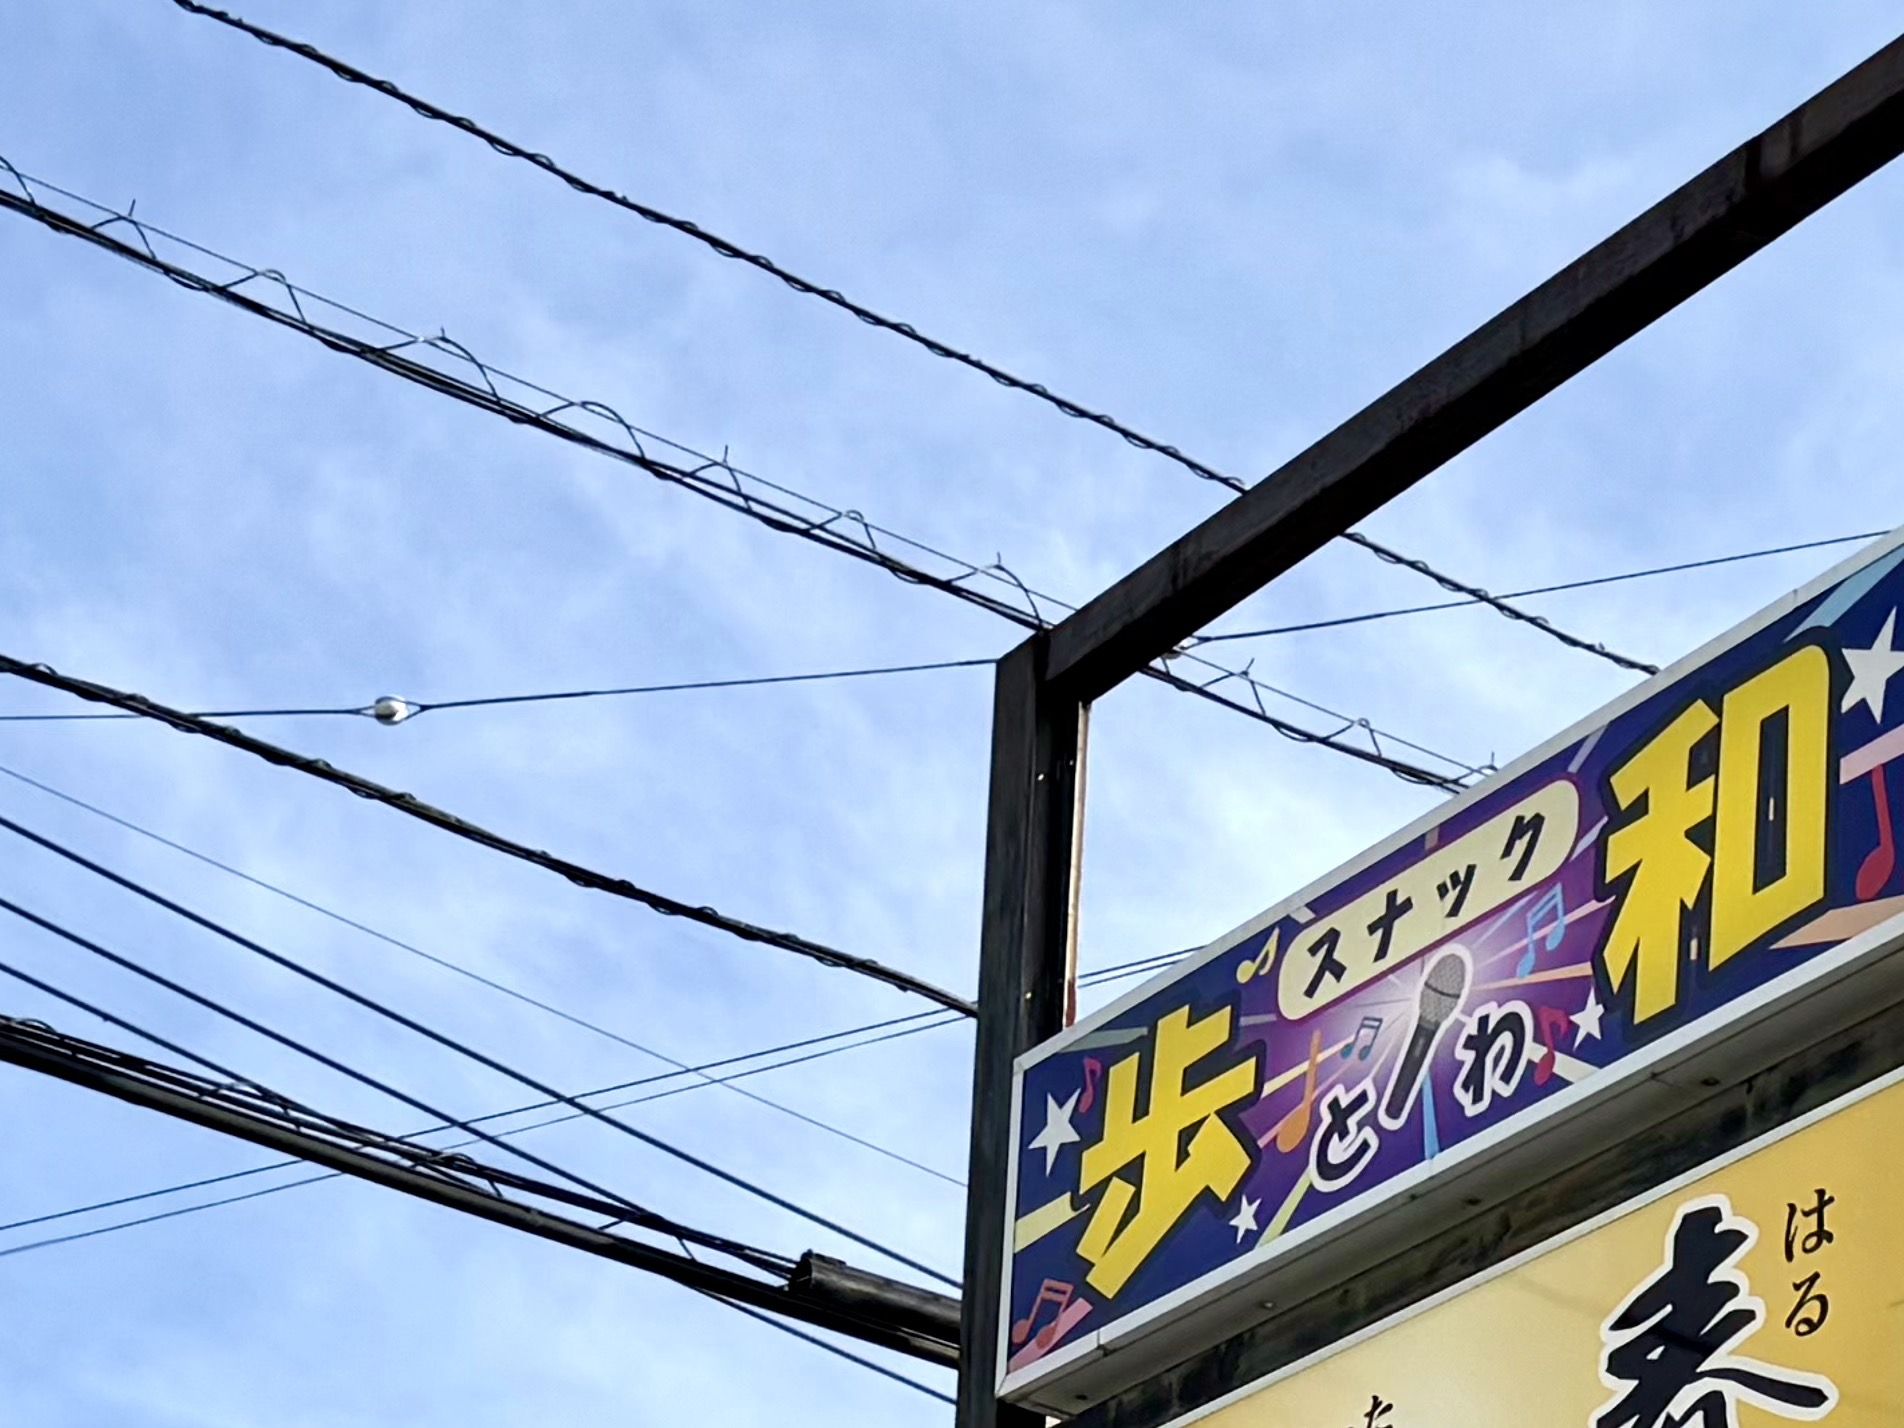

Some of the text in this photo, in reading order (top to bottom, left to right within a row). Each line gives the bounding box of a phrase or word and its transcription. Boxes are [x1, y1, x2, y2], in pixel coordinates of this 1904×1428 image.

[1076, 644, 1832, 1299] 歩 和
[1305, 813, 1546, 998] スナック
[1784, 1188, 1836, 1338] はる
